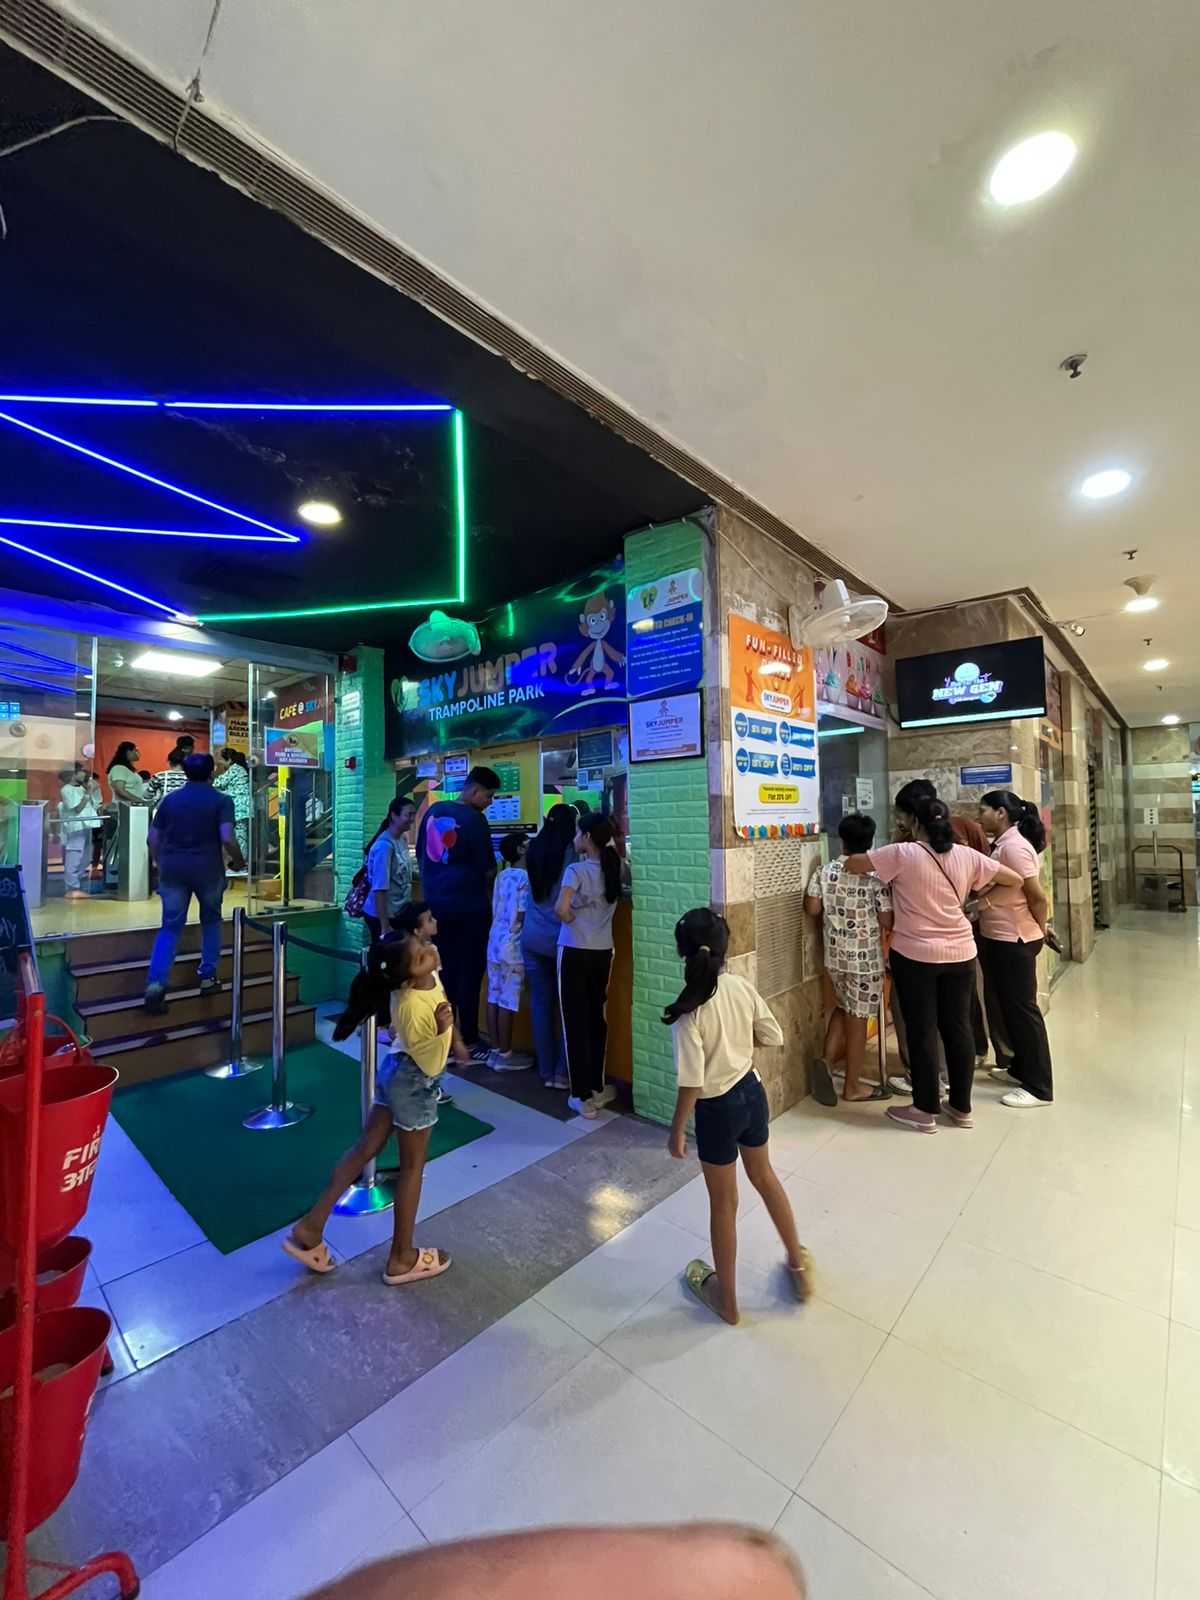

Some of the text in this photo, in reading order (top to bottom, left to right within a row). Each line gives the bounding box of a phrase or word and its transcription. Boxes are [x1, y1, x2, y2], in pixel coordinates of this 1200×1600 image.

[932, 686, 967, 700] NEW
[970, 681, 1003, 694] GEN
[429, 683, 545, 720] TRAMPOLINE PARK
[763, 760, 775, 768] OFF
